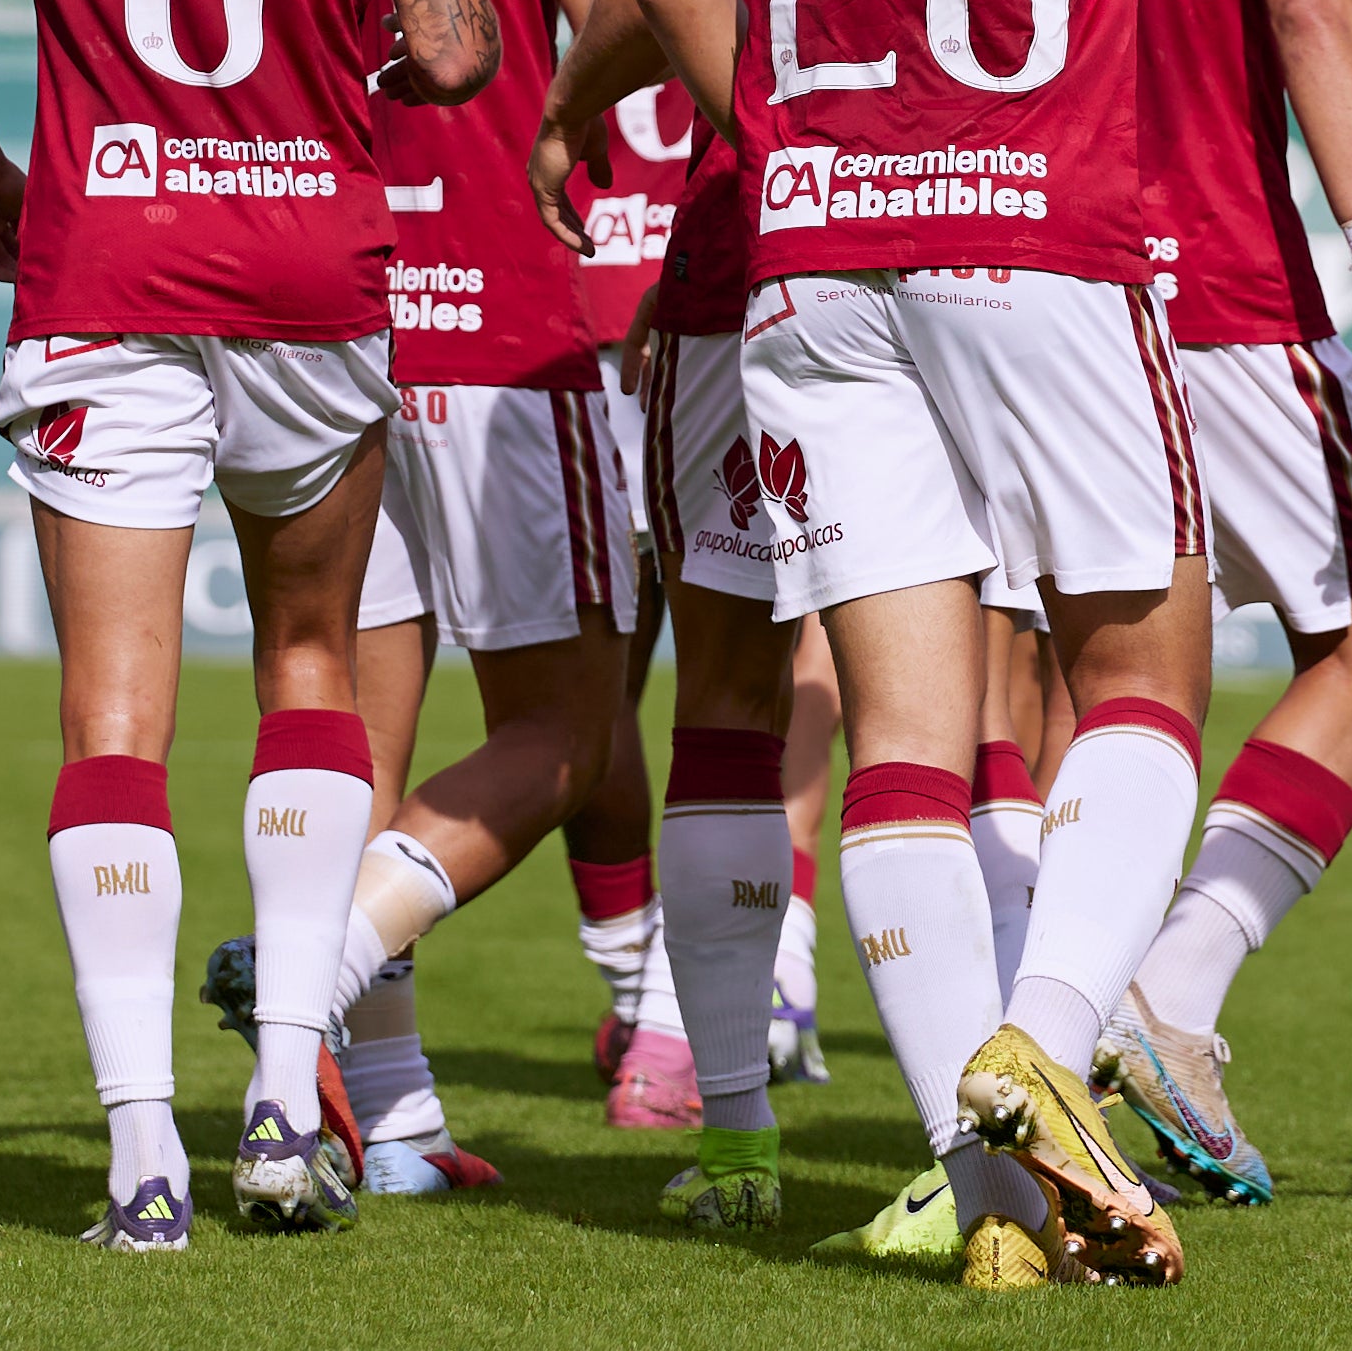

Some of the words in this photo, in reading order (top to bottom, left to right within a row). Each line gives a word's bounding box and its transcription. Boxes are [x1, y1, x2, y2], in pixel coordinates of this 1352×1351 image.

[94, 138, 152, 180] CA
[163, 134, 332, 164] cerramientos
[833, 144, 1048, 180] cerramientos
[163, 163, 337, 199] abatibles
[764, 167, 823, 210] CA
[830, 177, 1048, 220] abatibles
[896, 287, 1013, 312] Inmobiliarios
[257, 806, 308, 838] RMU
[93, 861, 152, 897] RMU
[731, 879, 779, 910] RMU
